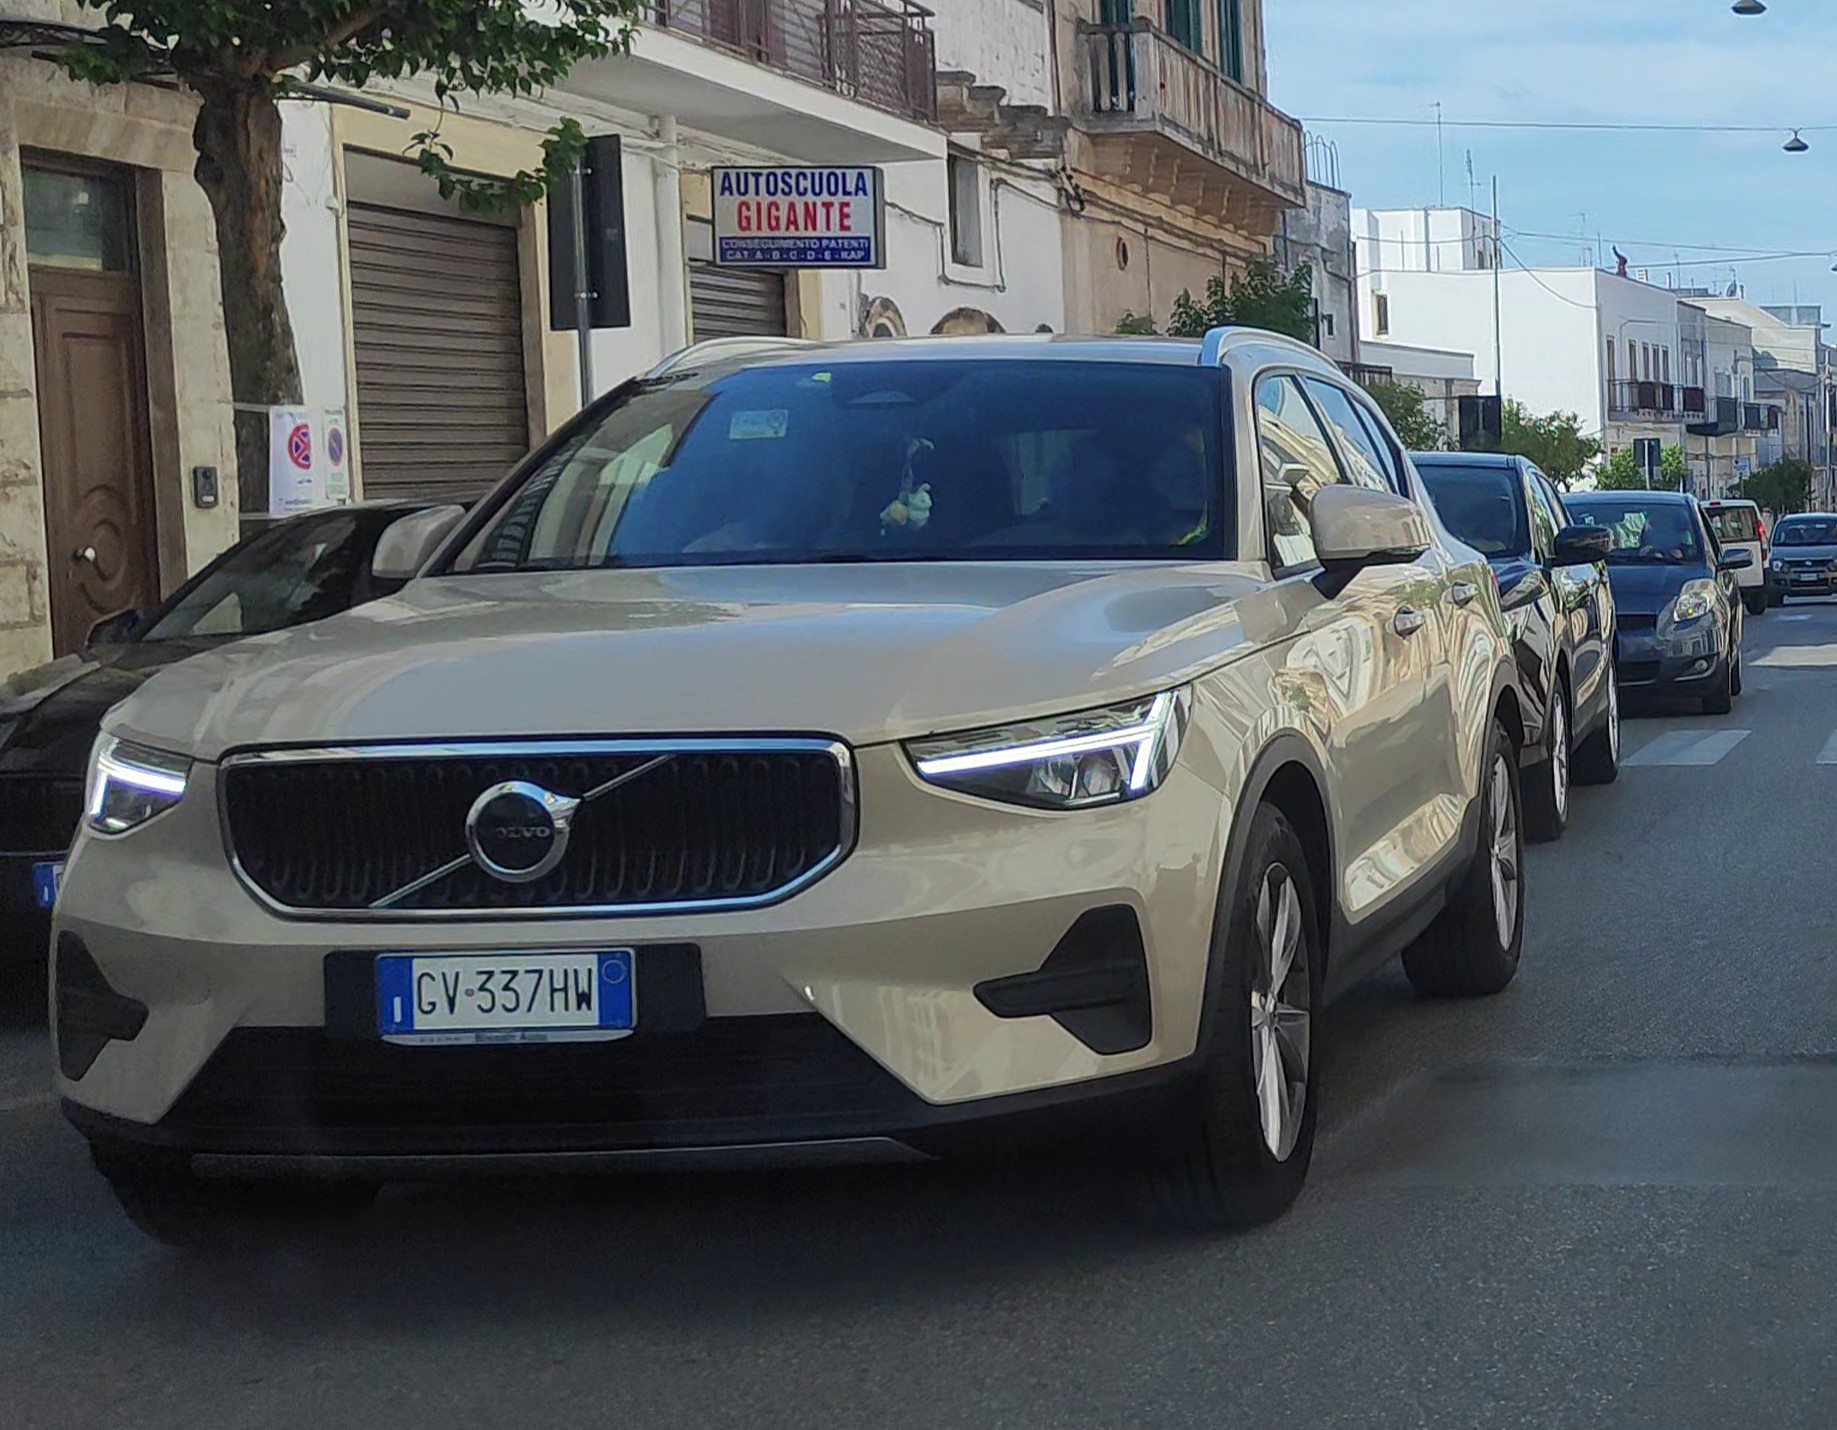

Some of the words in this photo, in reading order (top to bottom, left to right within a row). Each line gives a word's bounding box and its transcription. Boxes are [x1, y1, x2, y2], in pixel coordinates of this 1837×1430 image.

[720, 171, 868, 197] AUTOSCUOLA
[737, 201, 852, 232] GIGANTE
[722, 239, 820, 249] CONSEGUIMENTO
[822, 239, 869, 249] PATENTI
